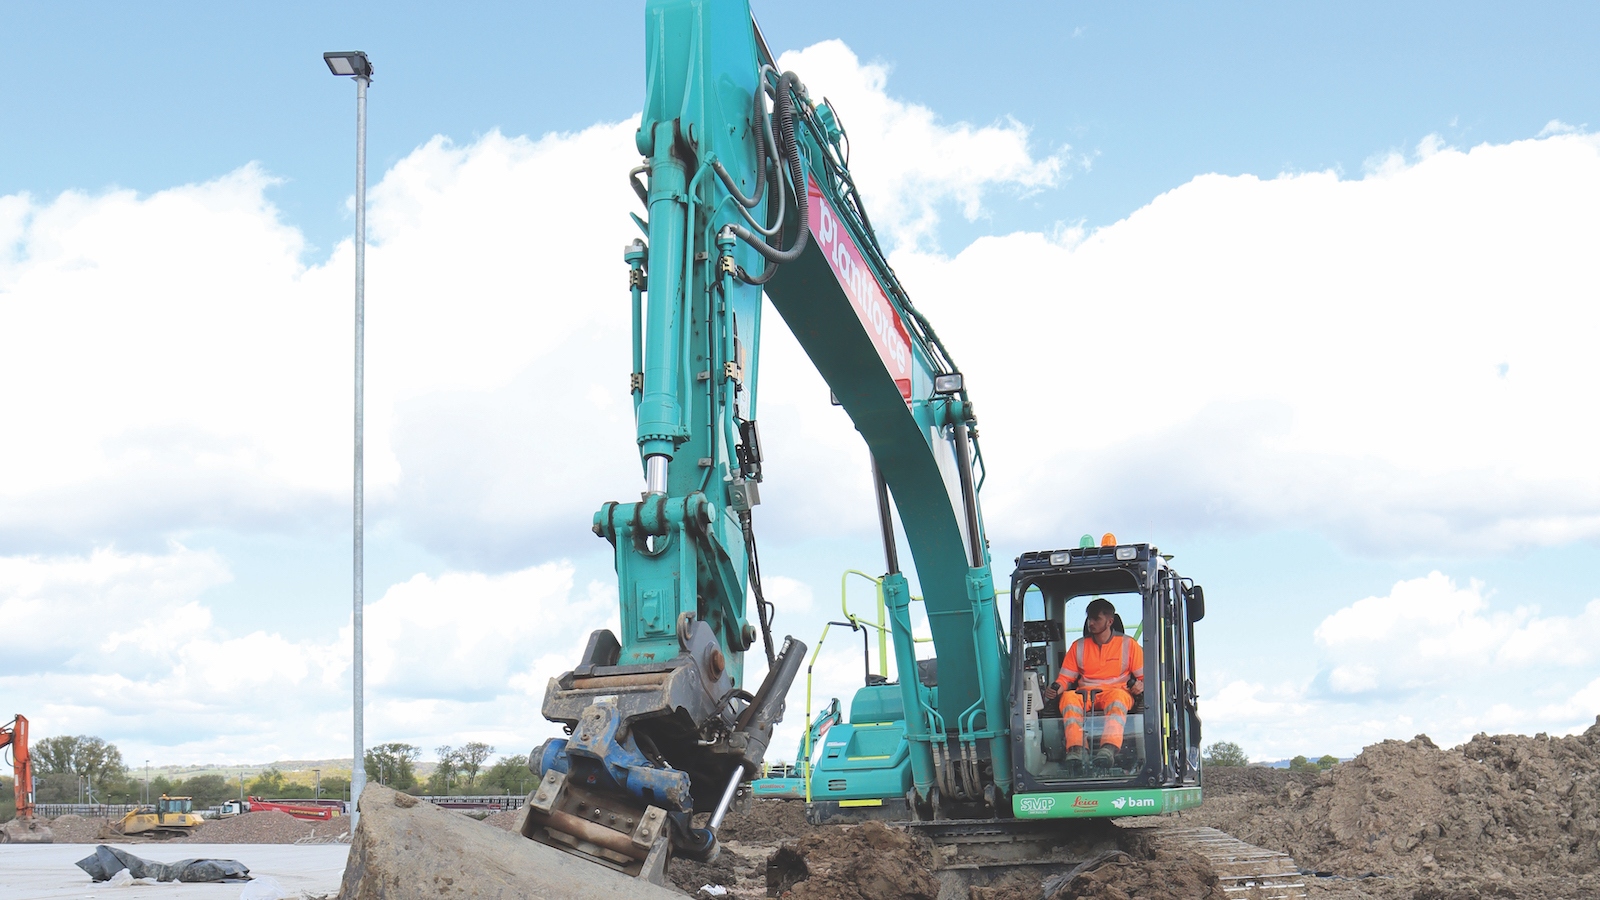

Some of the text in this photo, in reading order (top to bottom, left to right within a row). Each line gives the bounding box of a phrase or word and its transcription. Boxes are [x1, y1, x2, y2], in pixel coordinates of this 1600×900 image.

[819, 197, 907, 374] plantforce
[1020, 797, 1056, 811] SMP
[1070, 795, 1099, 808] Leica
[1128, 796, 1155, 808] bam
